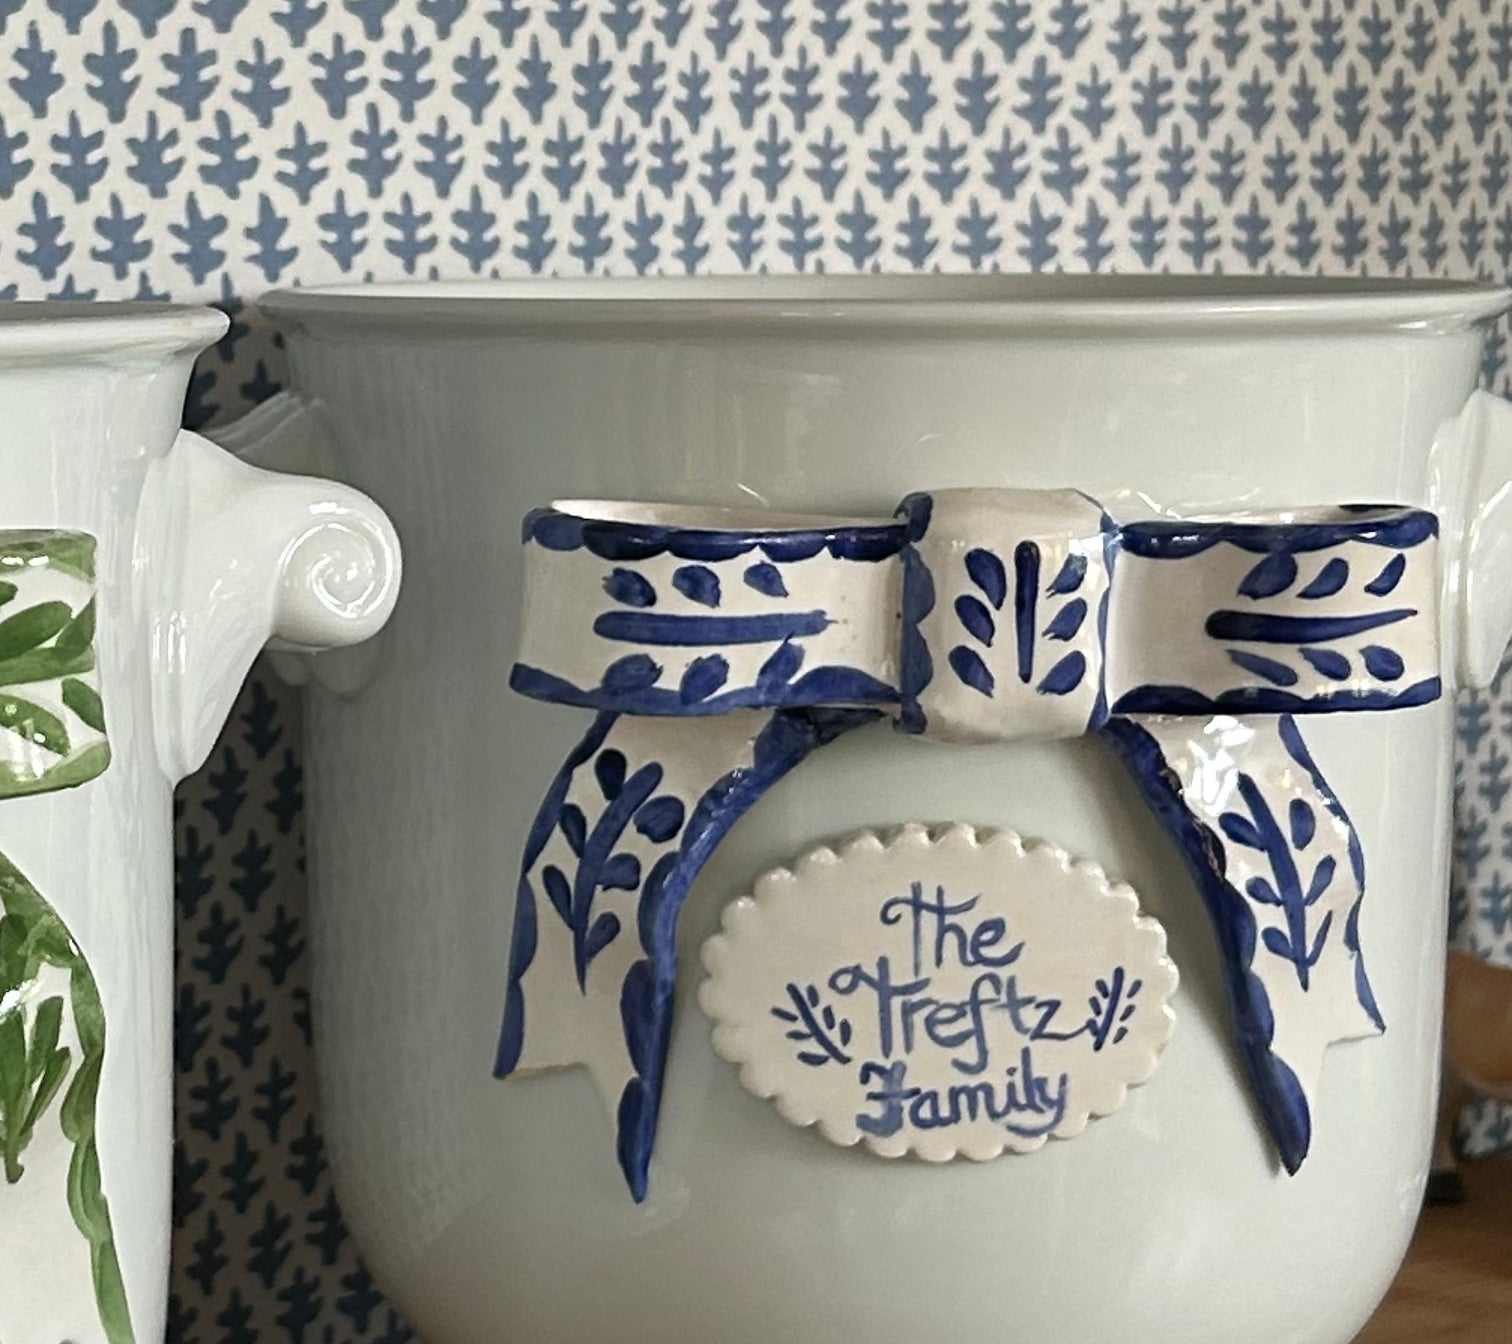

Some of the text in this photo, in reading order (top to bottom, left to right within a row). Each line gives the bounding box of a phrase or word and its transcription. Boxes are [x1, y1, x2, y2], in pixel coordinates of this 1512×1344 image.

[880, 880, 1026, 976] The
[828, 955, 1094, 1076] Treftz
[855, 1046, 1068, 1138] Family
